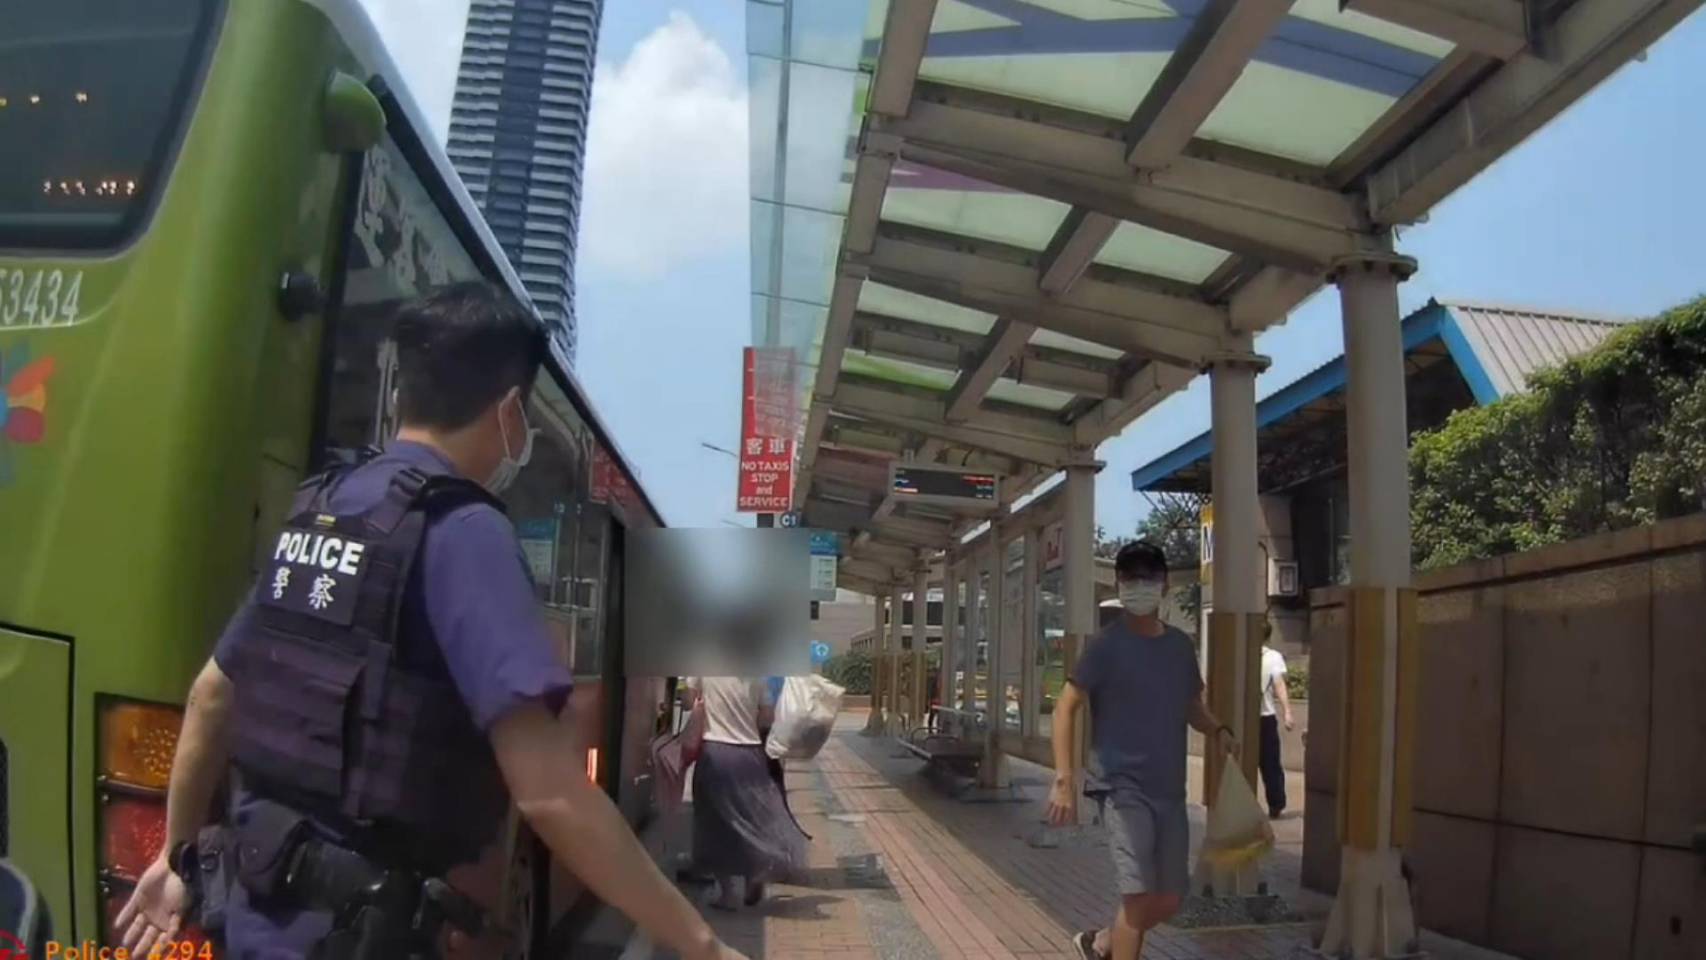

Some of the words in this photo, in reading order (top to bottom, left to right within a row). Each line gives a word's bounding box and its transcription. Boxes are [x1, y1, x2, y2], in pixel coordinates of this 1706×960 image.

[742, 460, 757, 471] NO
[758, 460, 789, 471] TAXIS
[751, 472, 778, 483] STOP
[756, 484, 773, 496] and
[740, 496, 788, 507] SERVICE
[274, 532, 365, 576] POLICE
[271, 567, 336, 609] 警察
